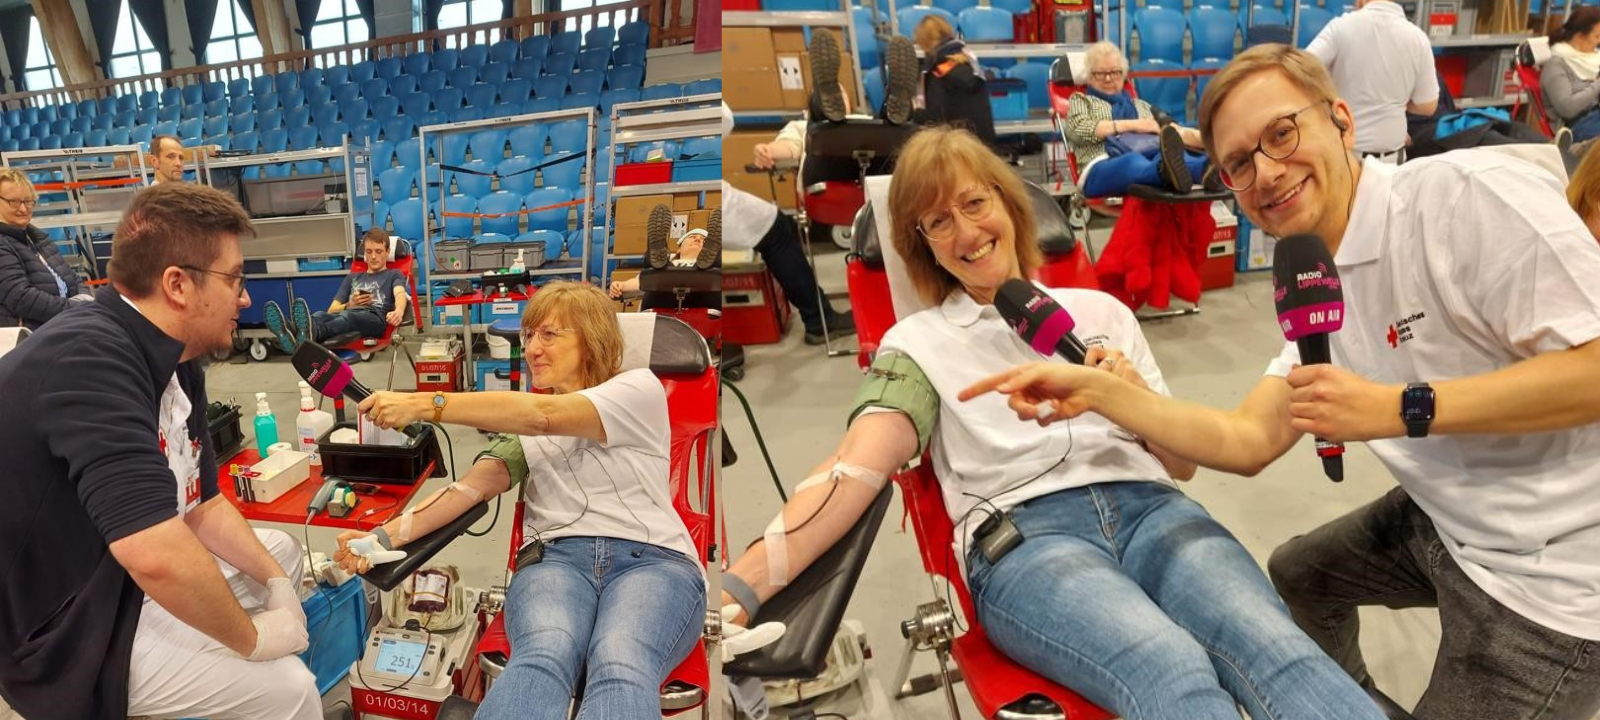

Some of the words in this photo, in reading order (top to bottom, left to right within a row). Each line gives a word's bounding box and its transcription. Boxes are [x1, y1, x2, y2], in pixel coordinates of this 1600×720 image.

[1297, 271, 1322, 281] RADIO
[1309, 311, 1325, 325] ON
[1327, 309, 1340, 322] AIR
[390, 655, 411, 668] 251
[365, 694, 429, 715] 01/03/14
